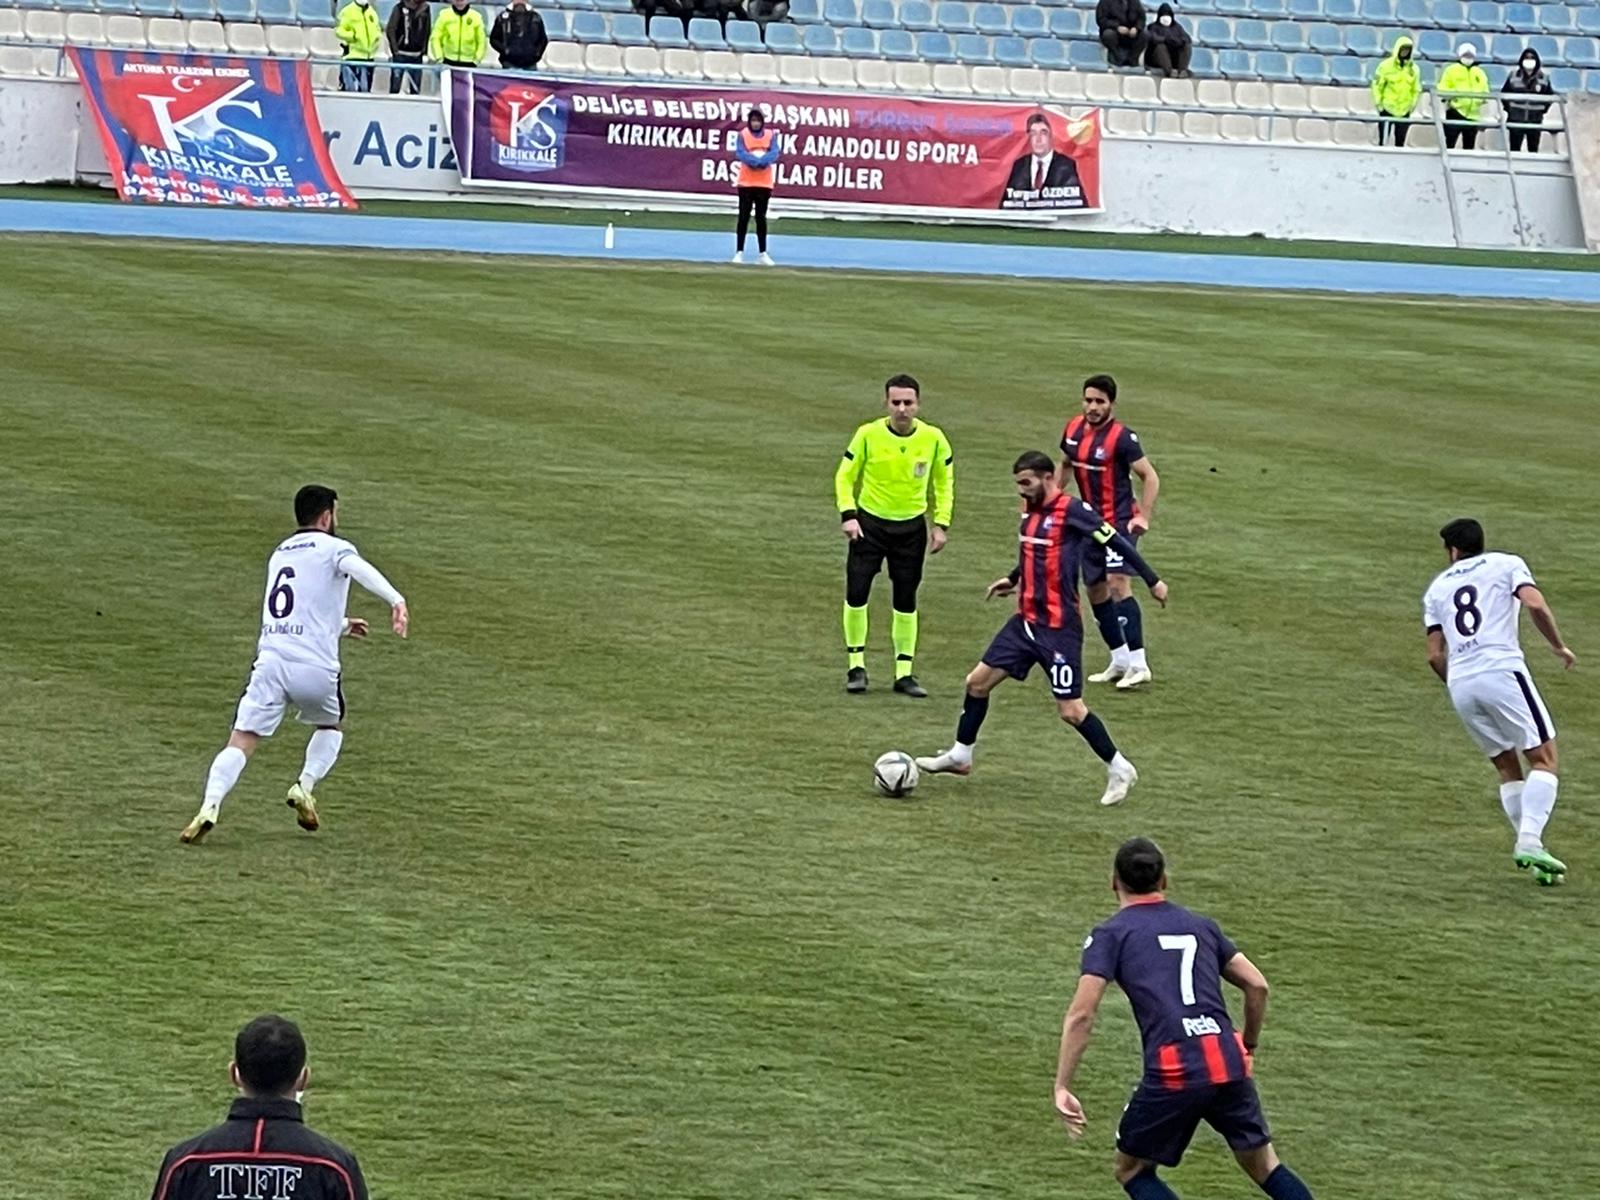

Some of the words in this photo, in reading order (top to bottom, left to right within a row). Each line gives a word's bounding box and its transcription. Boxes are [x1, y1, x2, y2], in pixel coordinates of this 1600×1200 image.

[572, 94, 647, 116] DELİCE
[758, 102, 850, 130] BAŞKANI
[499, 144, 557, 163] KIRIKKALE
[607, 123, 720, 149] KIRIKKALE
[802, 134, 900, 160] ANADOLU
[905, 140, 979, 165] SPOR'A
[140, 145, 293, 183] KIRIKKALE
[822, 162, 884, 190] DİLER
[268, 566, 296, 619] 6
[1453, 584, 1482, 637] 8
[1050, 664, 1073, 686] 10
[1158, 934, 1198, 1006] 7
[209, 1163, 302, 1200] TFF
